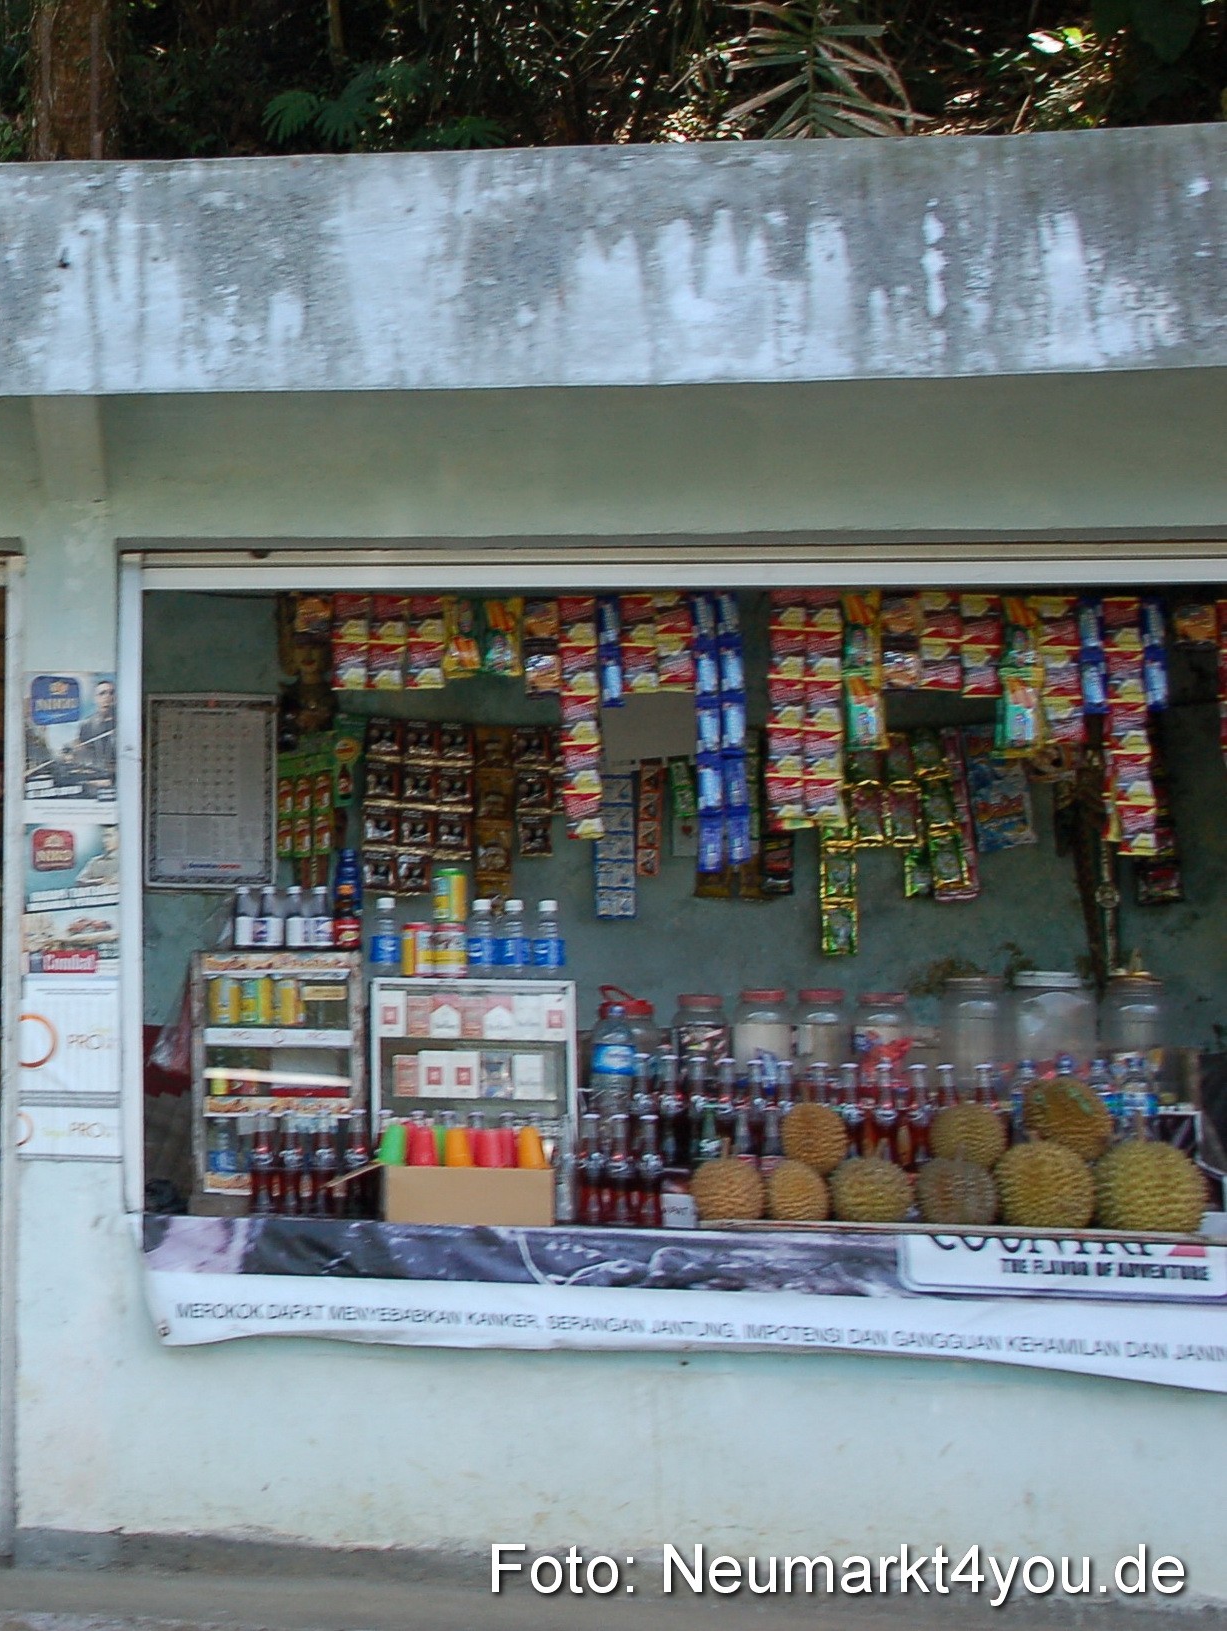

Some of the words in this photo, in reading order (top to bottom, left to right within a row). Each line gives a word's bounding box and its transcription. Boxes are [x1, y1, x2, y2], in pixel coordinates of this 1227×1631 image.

[1000, 1258, 1028, 1274] THE
[1034, 1260, 1088, 1277] FLAVOR
[1095, 1262, 1115, 1277] OF
[1118, 1263, 1210, 1281] ADVENTURE
[175, 1302, 264, 1320] MEROKOK
[268, 1303, 323, 1320] DAPAT
[329, 1305, 462, 1325] MENYEBABKAN
[547, 1315, 646, 1334] SERANGAN
[743, 1323, 844, 1344] IMPOTENSI
[848, 1328, 888, 1346] DAN
[893, 1330, 1002, 1351] GANGGUAN
[1006, 1335, 1121, 1357] KEHAMILAN
[1124, 1341, 1169, 1359] DAN
